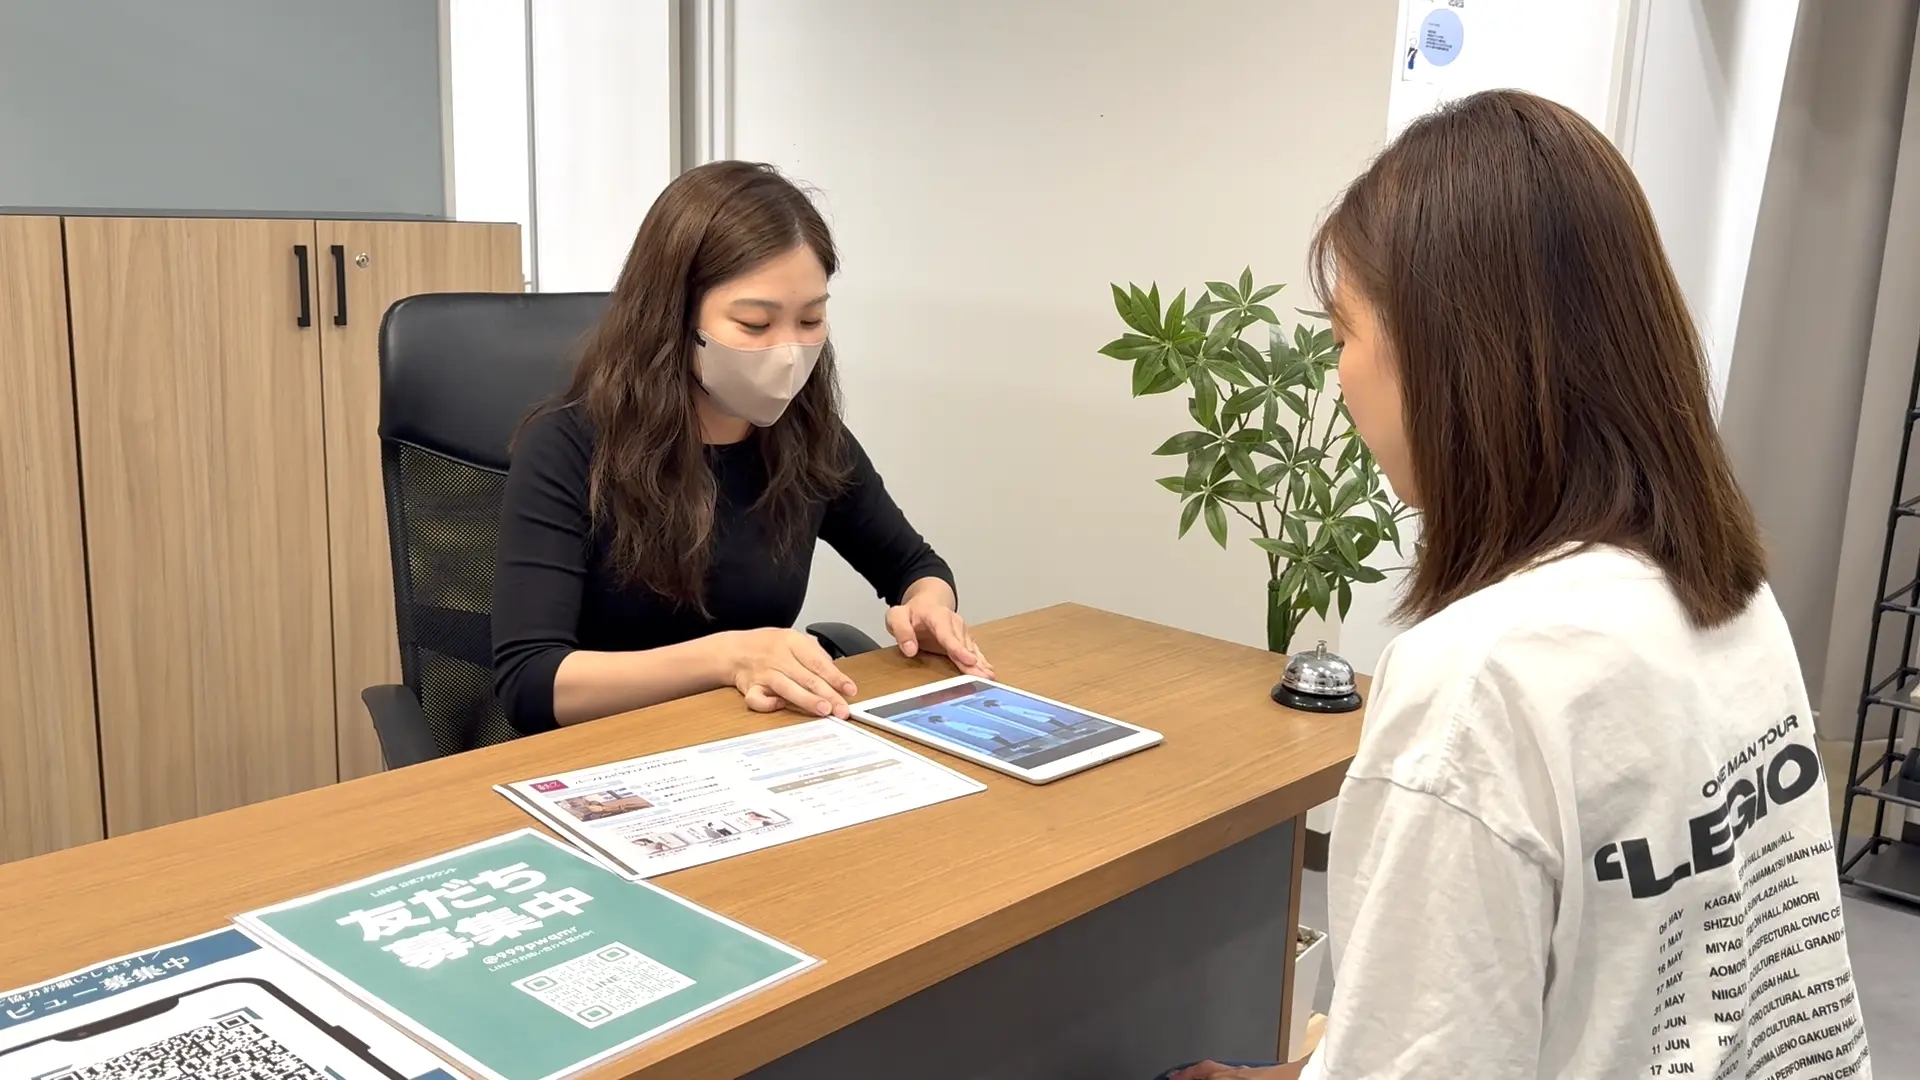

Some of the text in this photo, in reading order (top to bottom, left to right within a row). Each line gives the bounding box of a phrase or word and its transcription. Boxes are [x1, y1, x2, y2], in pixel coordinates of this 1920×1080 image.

[1702, 714, 1799, 798] ONE MAN TOUR
[1594, 733, 1825, 899] ‘LEGIO
[1786, 848, 1810, 864] MAIN
[1810, 840, 1833, 855] HALL
[370, 883, 397, 898] LINE
[1778, 875, 1799, 892] HALL
[336, 861, 547, 942] 友だち
[1704, 889, 1744, 911] KAGAW
[1762, 906, 1782, 922] HALL
[1782, 891, 1821, 913] AOMORI
[381, 886, 594, 970] 募集中
[1668, 908, 1684, 927] MAY
[1703, 914, 1745, 931] SHIZUO
[1801, 911, 1830, 928] CIVIC
[482, 925, 579, 965] @999pwqmr
[1659, 930, 1684, 954] 11 MAY
[1780, 943, 1804, 959] HALL
[1804, 930, 1841, 950] GRAND
[1667, 951, 1683, 969] MAY
[585, 974, 621, 992] LINE
[1656, 971, 1683, 996] 17 MAY
[1776, 968, 1800, 984] HALL
[1664, 993, 1686, 1009] MAY
[1763, 989, 1806, 1016] CULTURAL
[1806, 980, 1835, 996] ARTS
[1664, 1015, 1687, 1030] JUN
[1765, 1011, 1811, 1038] CULTURAL
[1811, 1002, 1840, 1018] ARTS
[1652, 1038, 1690, 1055] 11 JUN
[1775, 1038, 1798, 1057] UENO
[1798, 1023, 1842, 1045] GAKUEN
[1842, 1014, 1857, 1030] HALL
[1650, 1062, 1694, 1076] 17 JUN
[1775, 1050, 1834, 1080] PERFORMING
